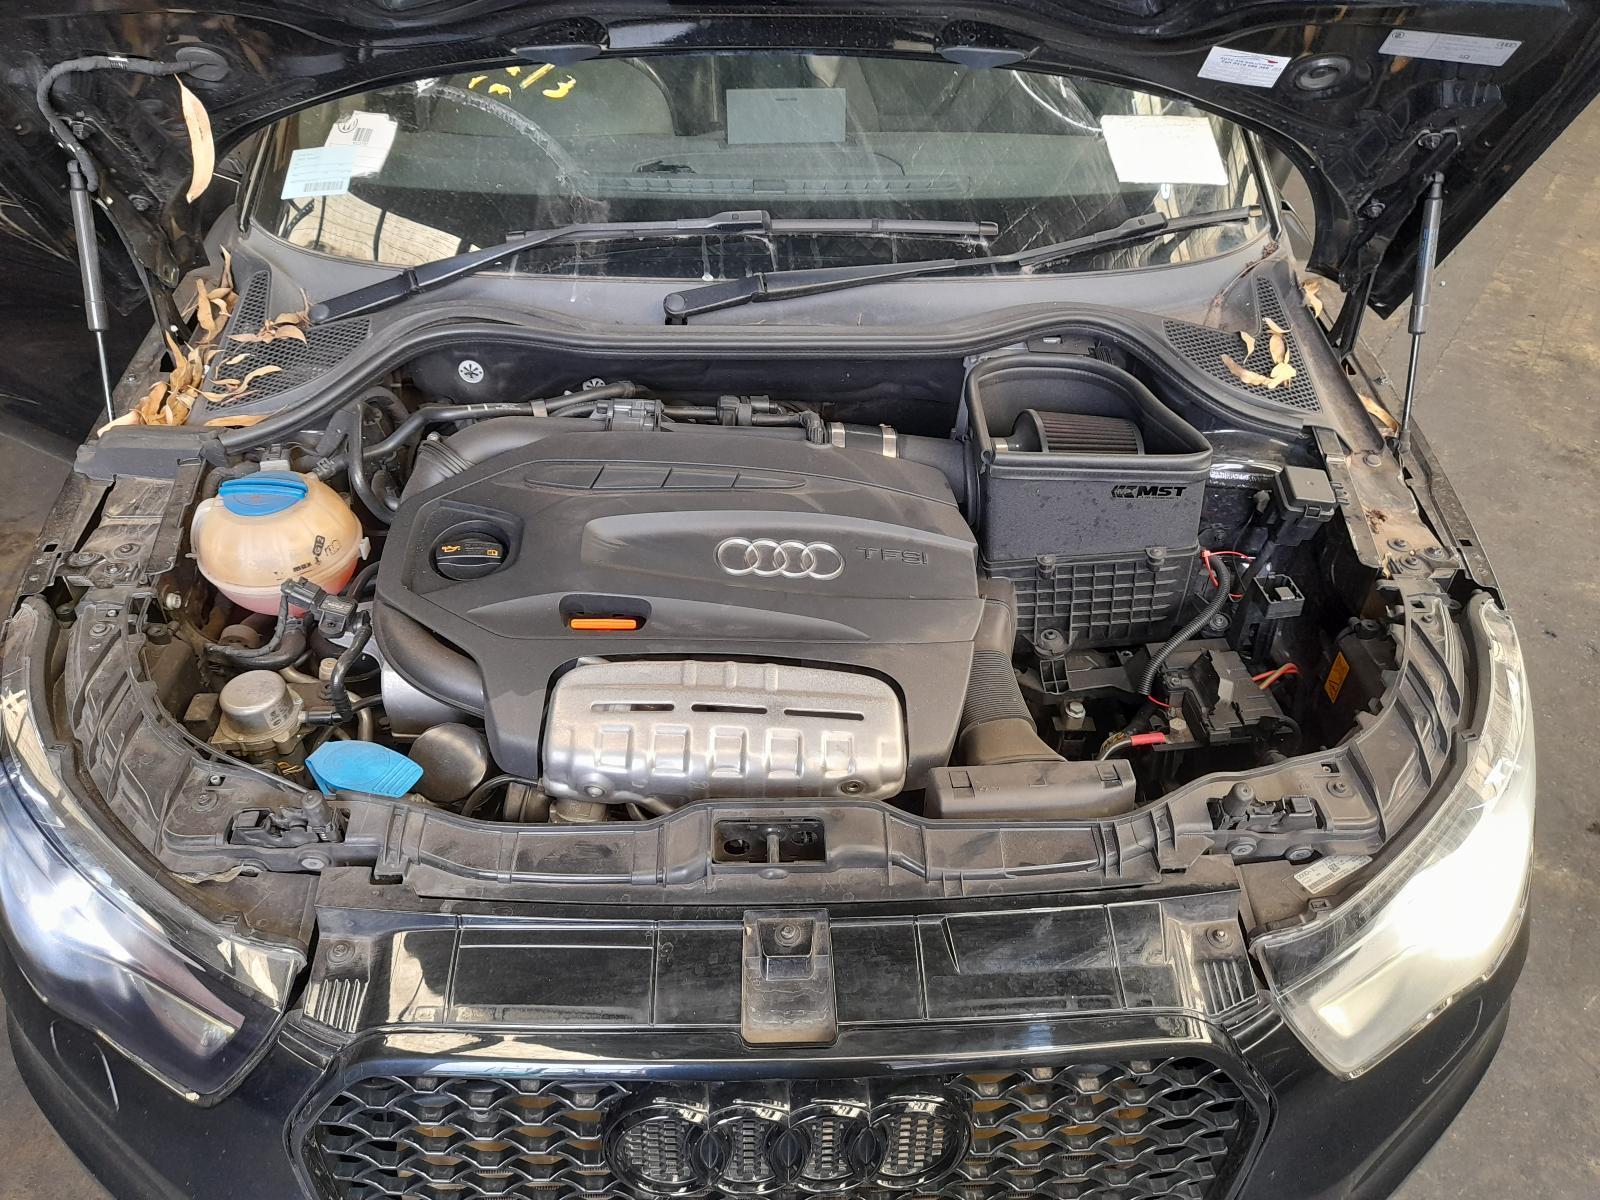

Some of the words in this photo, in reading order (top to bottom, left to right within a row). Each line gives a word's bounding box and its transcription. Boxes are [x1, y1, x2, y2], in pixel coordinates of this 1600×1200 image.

[1137, 486, 1187, 498] MST
[313, 536, 325, 556] G12
[856, 546, 929, 565] TFSI
